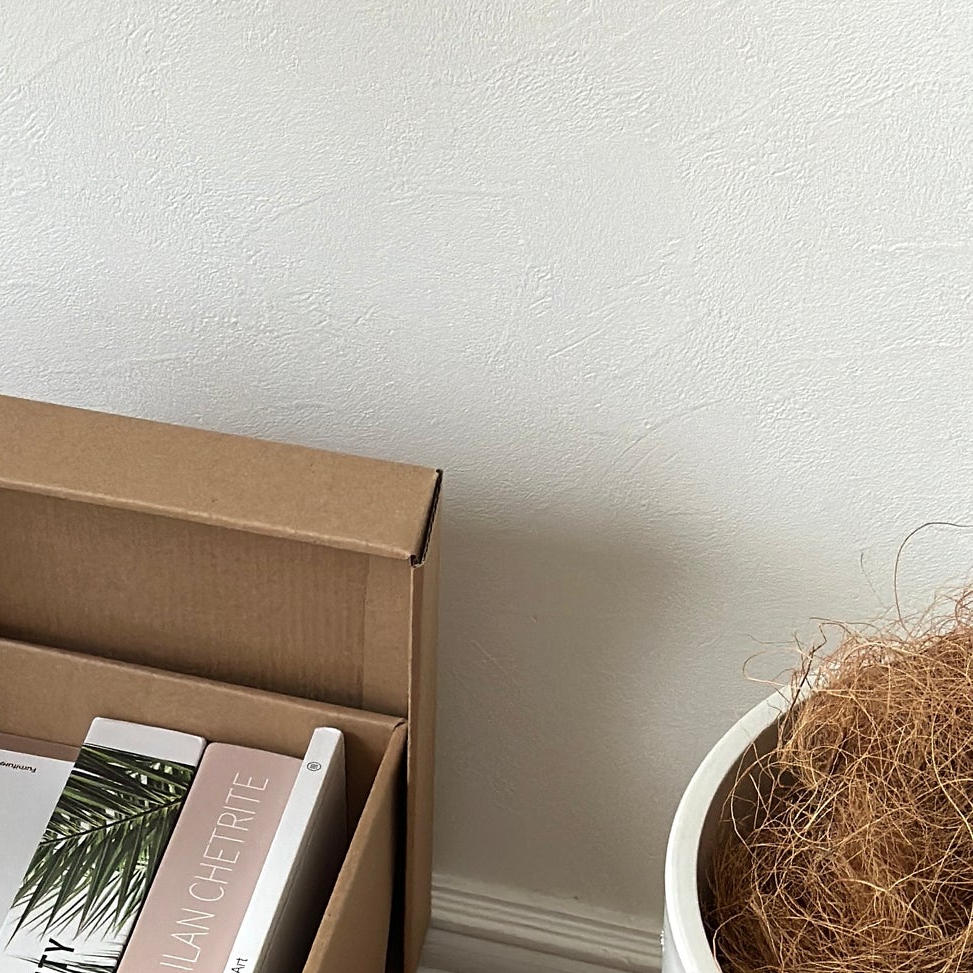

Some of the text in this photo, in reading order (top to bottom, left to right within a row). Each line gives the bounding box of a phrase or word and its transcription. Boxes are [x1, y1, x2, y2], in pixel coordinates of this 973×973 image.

[0, 761, 36, 773] Furniture
[160, 772, 269, 970] ILAN CHETRITE
[231, 957, 248, 973] Art
